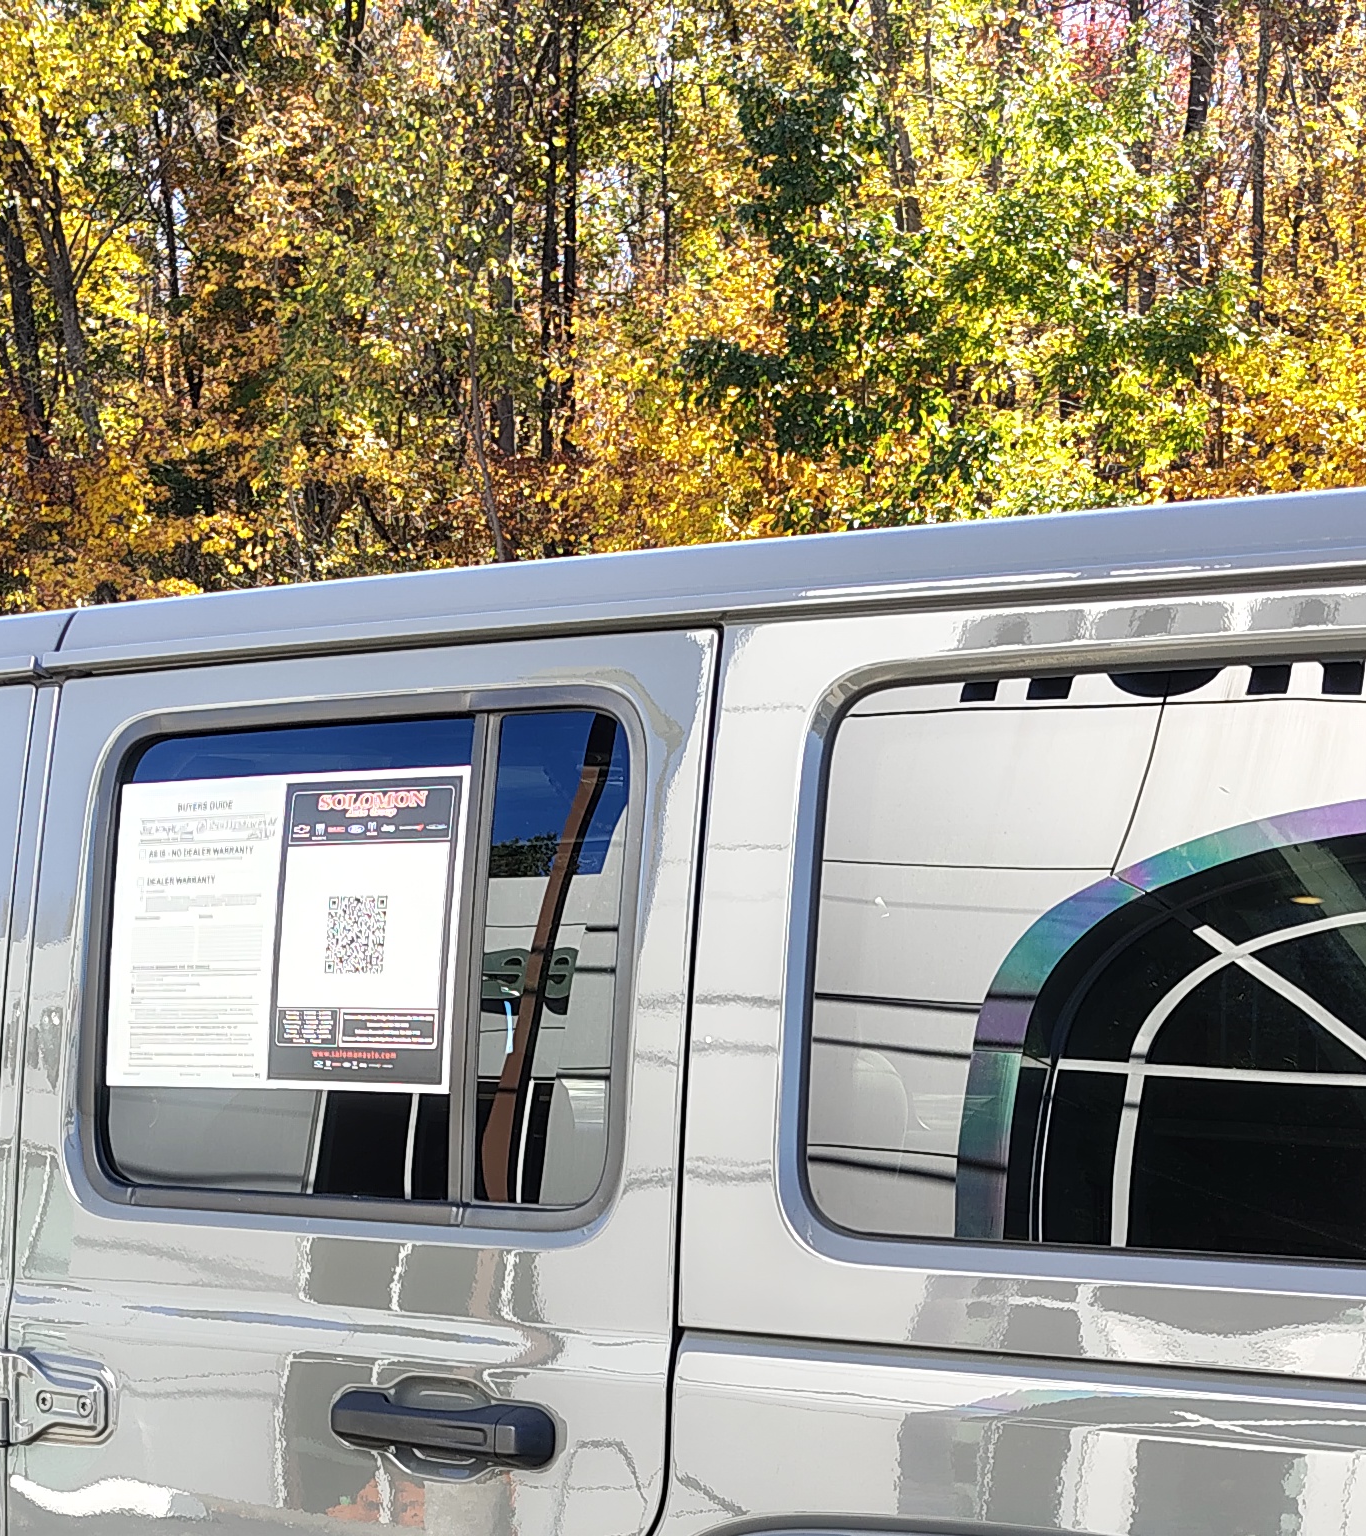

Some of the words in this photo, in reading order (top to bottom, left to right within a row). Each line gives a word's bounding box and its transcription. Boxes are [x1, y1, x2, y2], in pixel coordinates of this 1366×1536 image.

[177, 801, 208, 812] BUYERS
[209, 800, 233, 810] GUIDE
[317, 790, 429, 811] SOLOMON
[172, 848, 182, 857] NO
[183, 847, 212, 857] DEALER
[212, 845, 254, 855] WARRANTY
[146, 877, 174, 887] DEALER
[176, 875, 216, 885] WARRANTY
